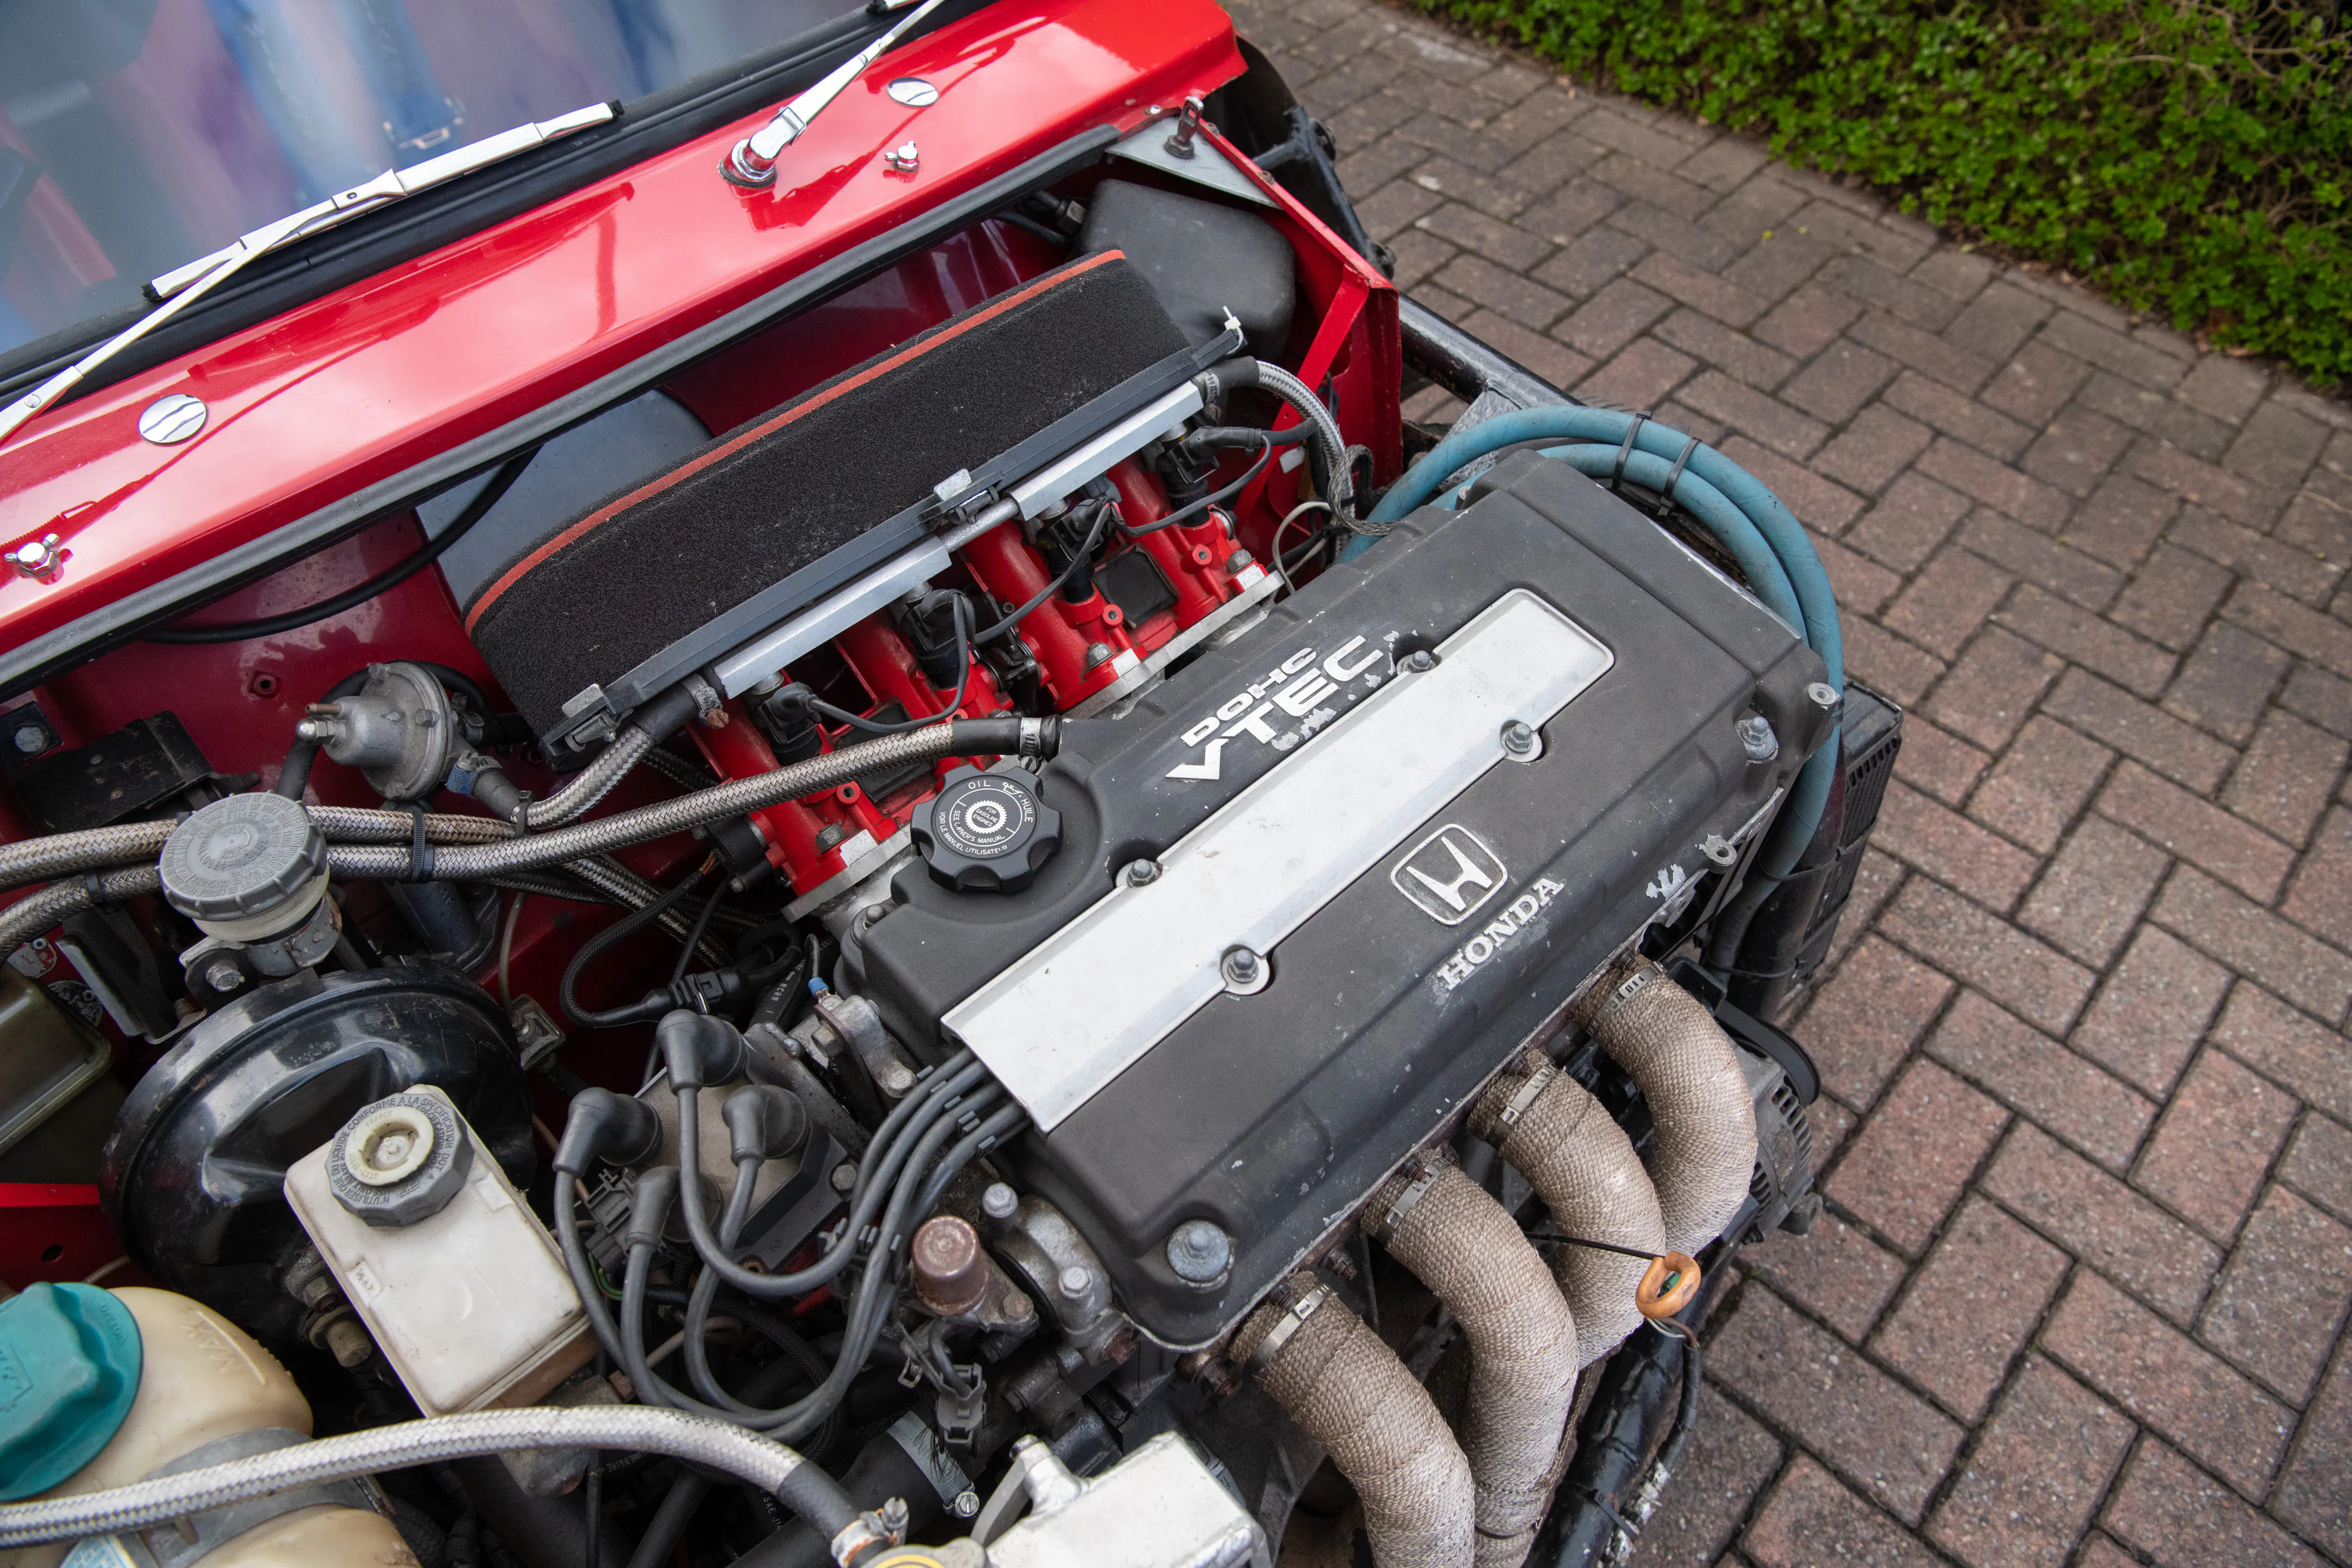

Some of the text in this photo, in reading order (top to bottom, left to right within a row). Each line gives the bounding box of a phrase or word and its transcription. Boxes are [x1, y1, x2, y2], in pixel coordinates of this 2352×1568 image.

[1180, 648, 1317, 747] DOHC
[1165, 635, 1384, 780] VTEC
[968, 780, 1034, 823] OIL HUILE
[201, 809, 224, 824] ONLY
[258, 813, 276, 825] CAP
[975, 808, 999, 823] GASOLINE
[986, 807, 997, 815] FOR
[972, 814, 993, 827] ENGINES
[940, 824, 948, 833] LE
[944, 832, 964, 851] MANUEL
[977, 834, 1006, 843] MANUAL
[1437, 877, 1565, 991] HONDA
[398, 1096, 407, 1104] A
[406, 1095, 421, 1104] LA
[344, 1097, 396, 1132] CONFORME
[417, 1097, 457, 1149] SPECIFICATION
[330, 1131, 351, 1164] LIQUIDE
[330, 1163, 341, 1178] DU
[432, 1152, 451, 1172] DOT
[332, 1175, 350, 1194] QUE
[351, 1181, 374, 1196] ONLY
